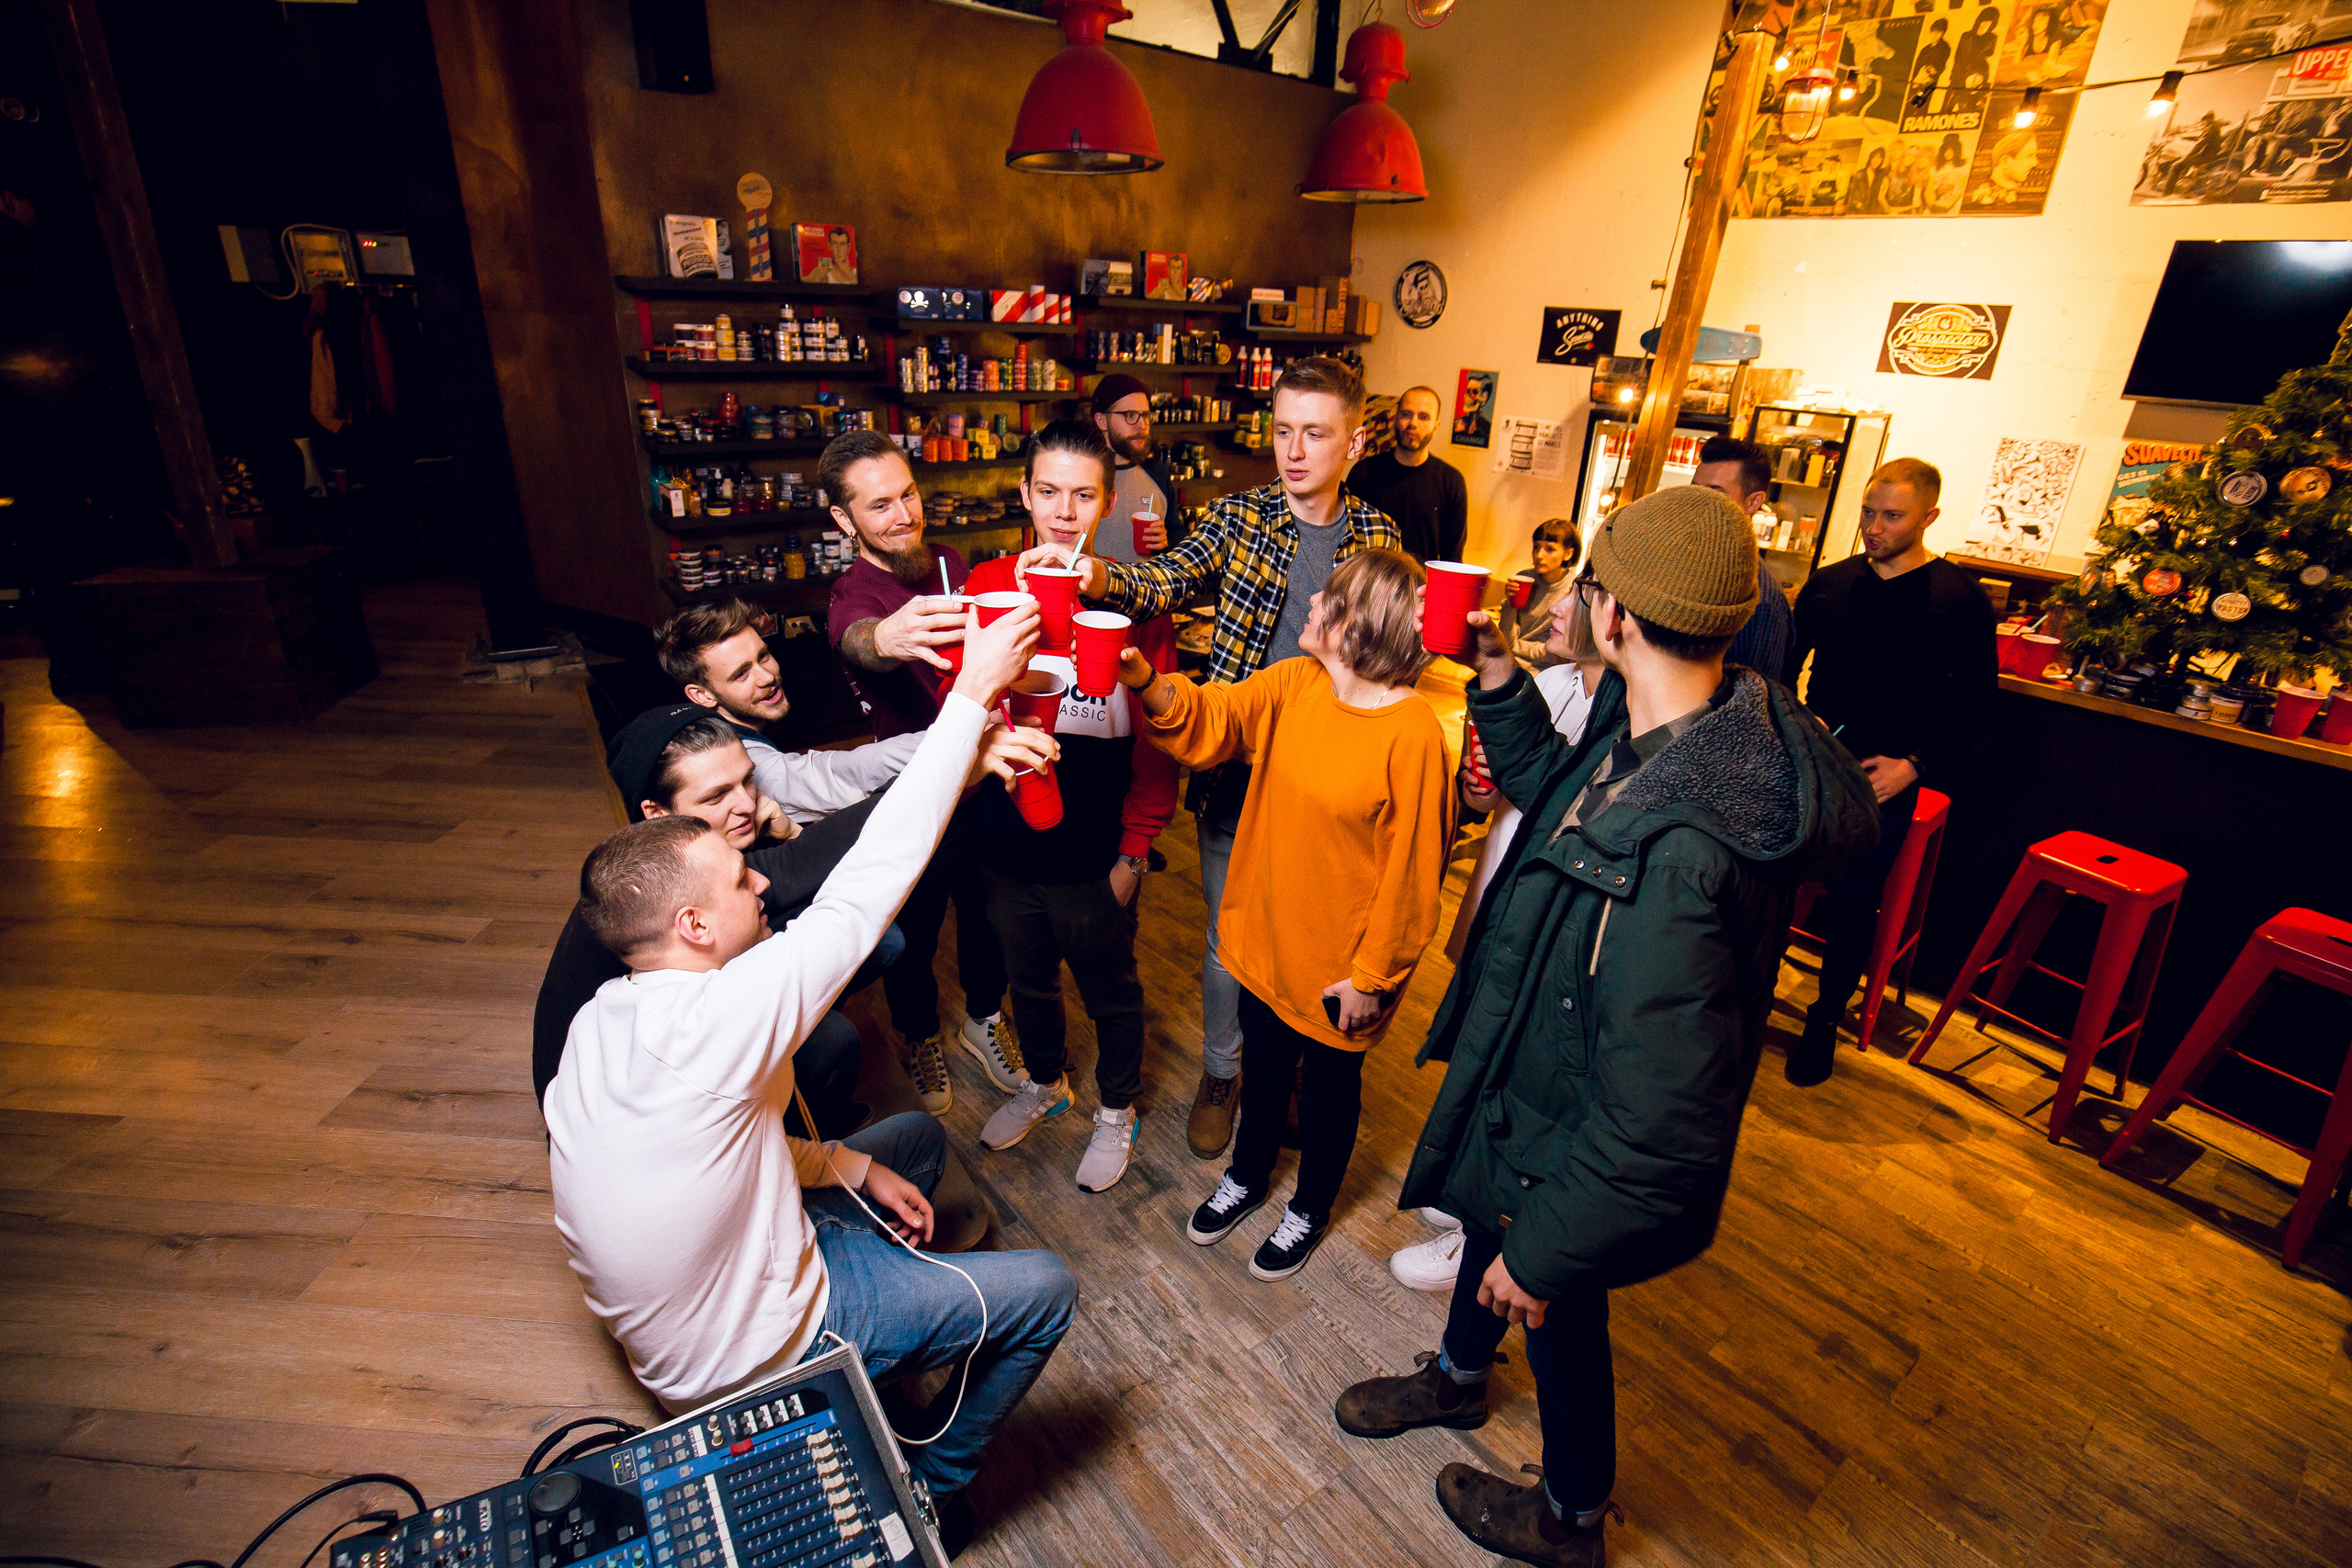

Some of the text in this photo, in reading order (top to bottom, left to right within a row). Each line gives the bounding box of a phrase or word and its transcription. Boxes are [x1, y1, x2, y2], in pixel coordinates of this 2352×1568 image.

[1903, 112, 1980, 132] RAMONES
[2123, 442, 2202, 467] SUAVECIT
[1058, 704, 1106, 722] ASSIC
